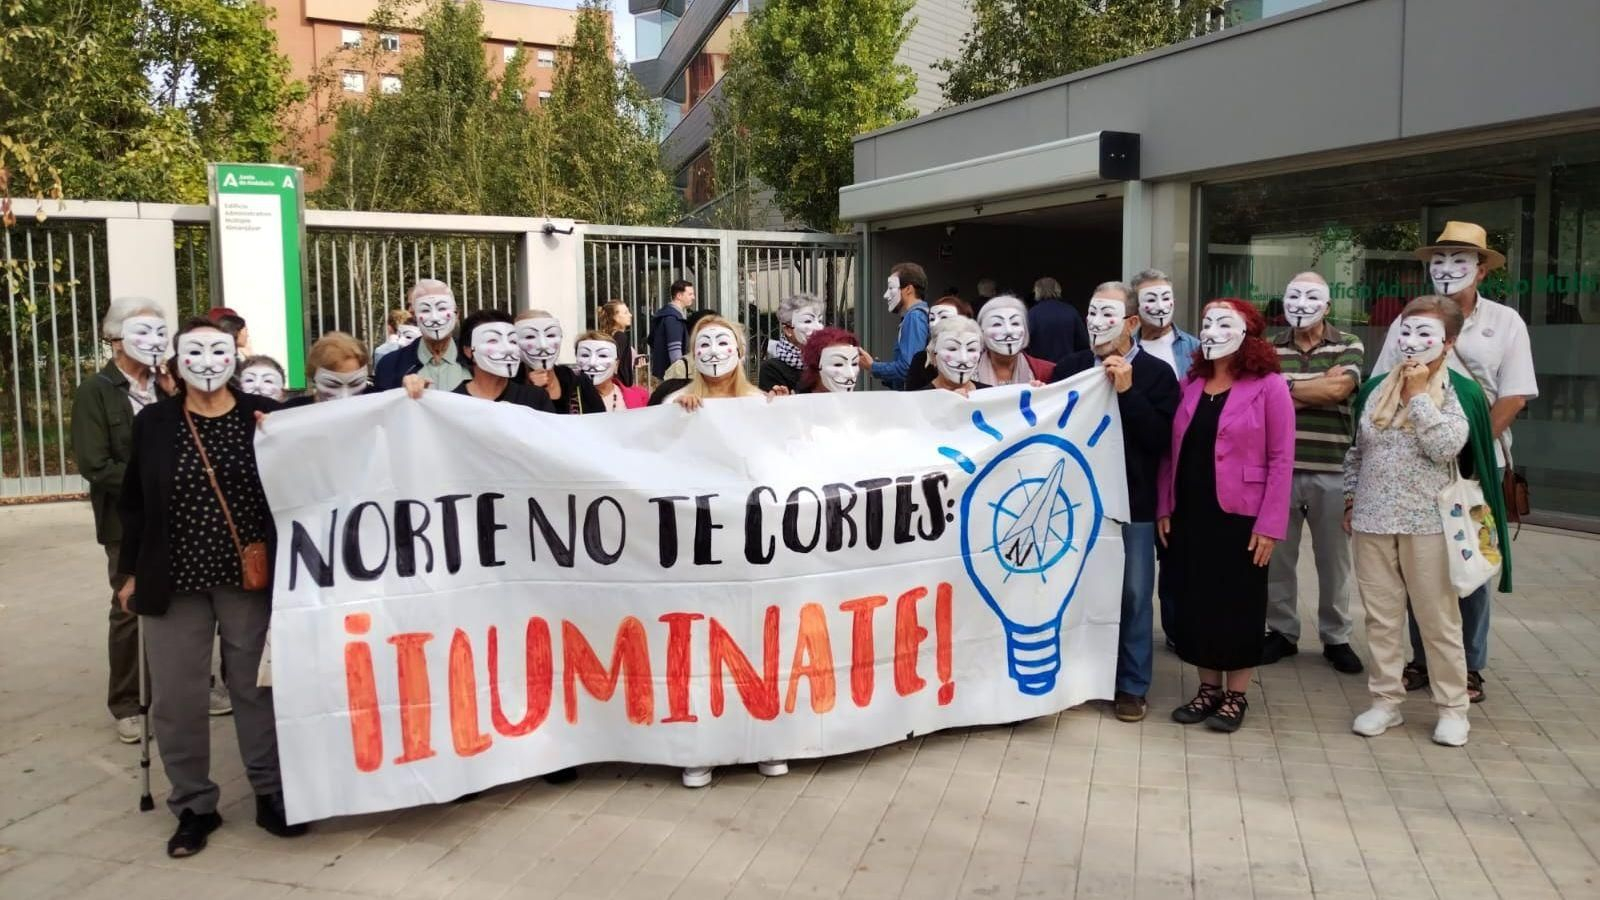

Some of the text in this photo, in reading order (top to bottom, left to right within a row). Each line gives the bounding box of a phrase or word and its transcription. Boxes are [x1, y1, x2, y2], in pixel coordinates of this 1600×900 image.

[288, 471, 956, 591] NORTE NO TE CORTES:
